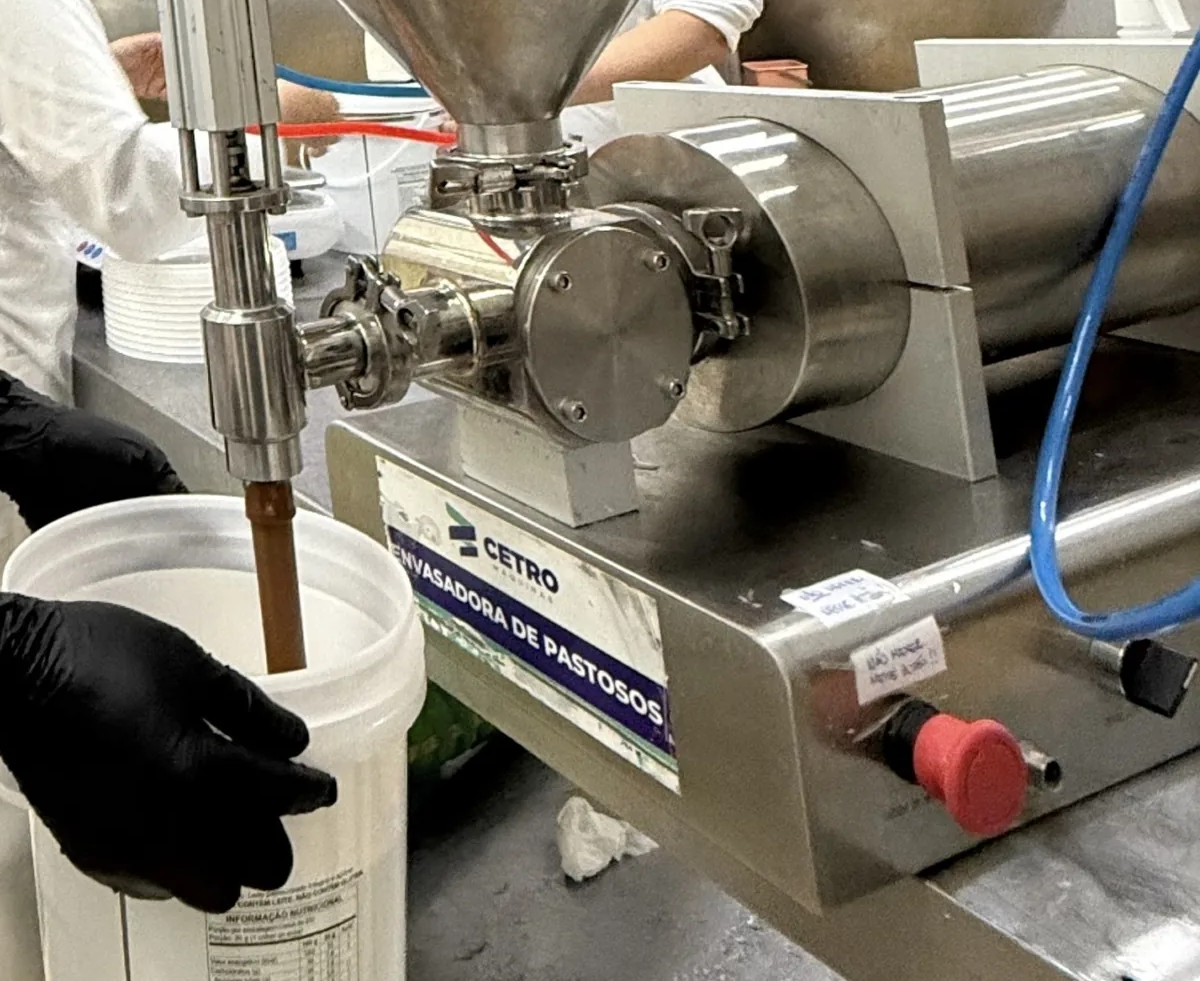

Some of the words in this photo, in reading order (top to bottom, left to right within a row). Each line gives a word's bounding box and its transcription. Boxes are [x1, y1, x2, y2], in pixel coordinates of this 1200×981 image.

[483, 536, 559, 594] CETRO
[390, 543, 509, 631] ENVASADORA
[511, 615, 540, 649] DE
[543, 634, 664, 726] PASTOSOS
[226, 909, 289, 924] INFORMAÇÃO
